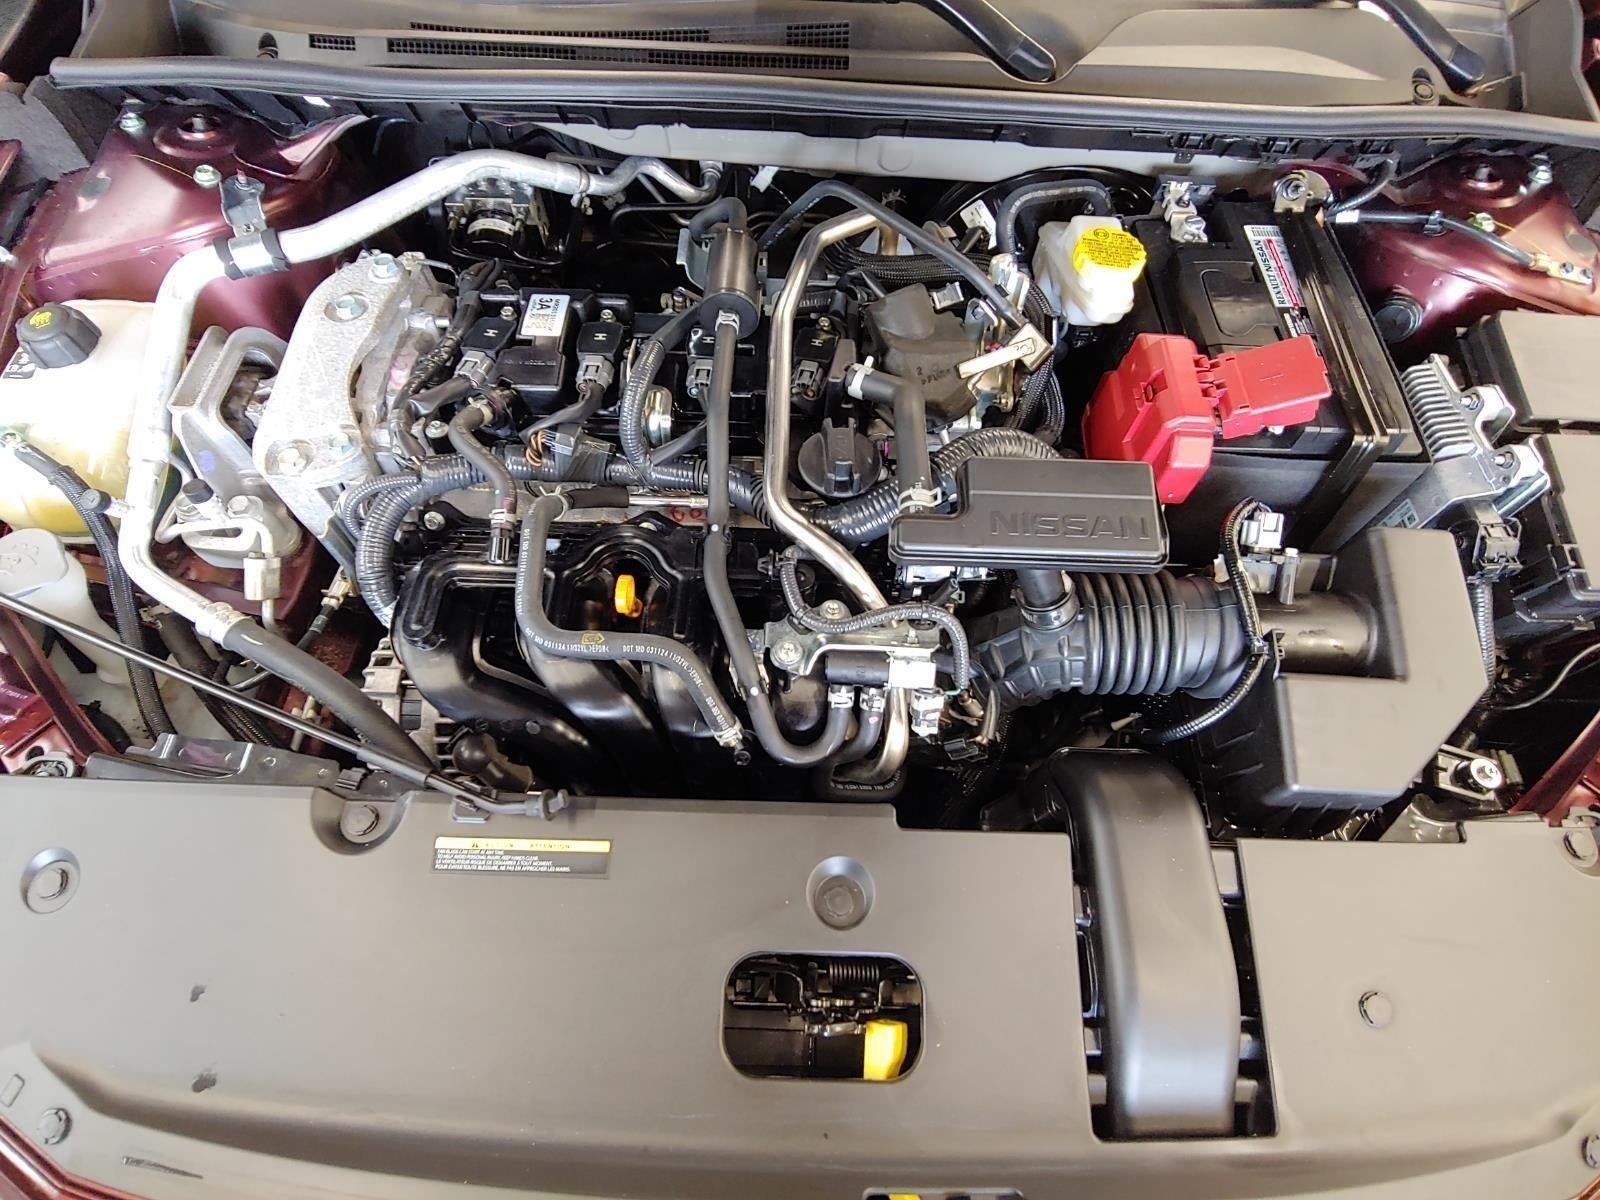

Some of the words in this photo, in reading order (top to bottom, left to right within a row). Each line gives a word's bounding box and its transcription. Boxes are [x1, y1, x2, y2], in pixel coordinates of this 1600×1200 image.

[1254, 239, 1273, 272] NISSAN
[536, 297, 553, 311] 3A
[1267, 273, 1287, 305] RENAULT
[990, 510, 1152, 540] NISSAN
[646, 646, 669, 658] 031124
